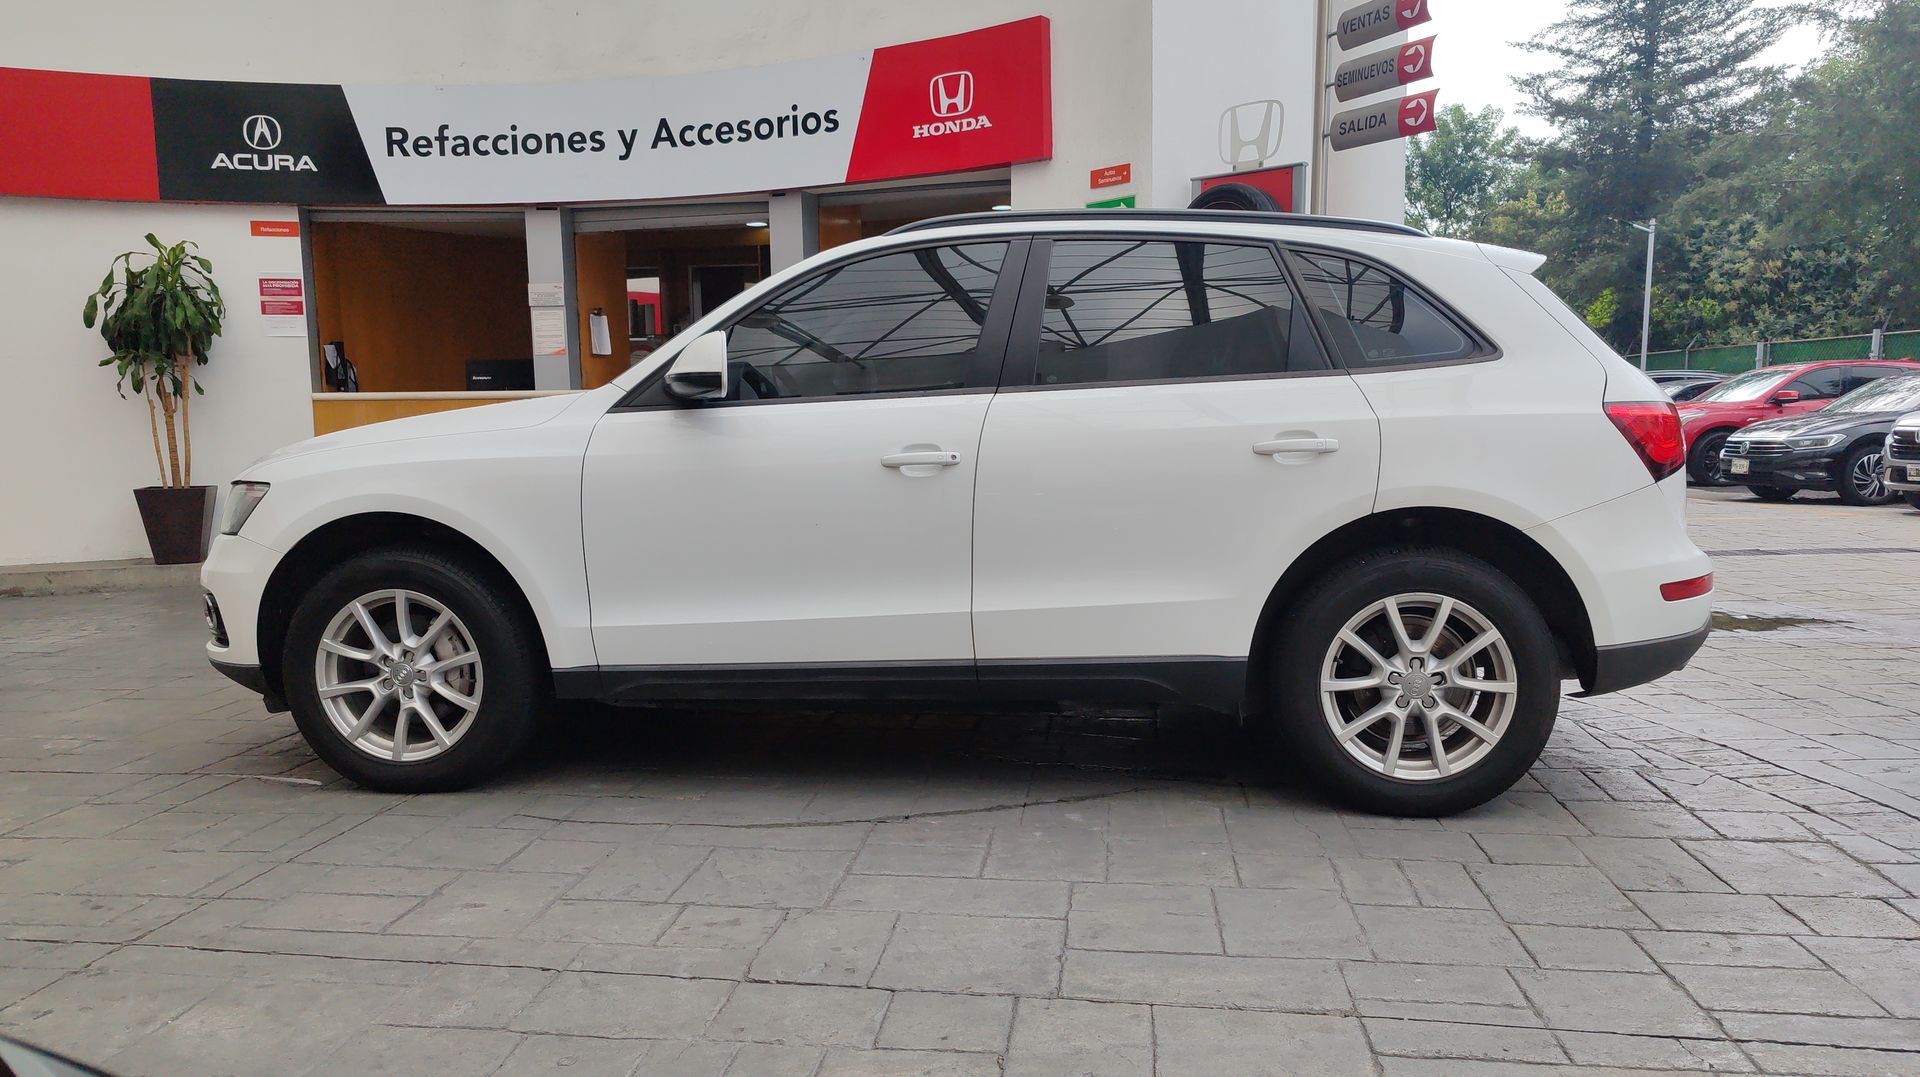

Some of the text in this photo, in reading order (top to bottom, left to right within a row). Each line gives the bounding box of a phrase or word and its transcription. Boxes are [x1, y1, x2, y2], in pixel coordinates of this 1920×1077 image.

[1342, 5, 1391, 35] VENTAS
[1337, 58, 1395, 88] SEMINUEVOS
[385, 104, 840, 161] Refacciones y Accesorios
[912, 114, 992, 139] HONDA
[1339, 112, 1387, 136] SALIDA
[210, 153, 318, 172] ACURA
